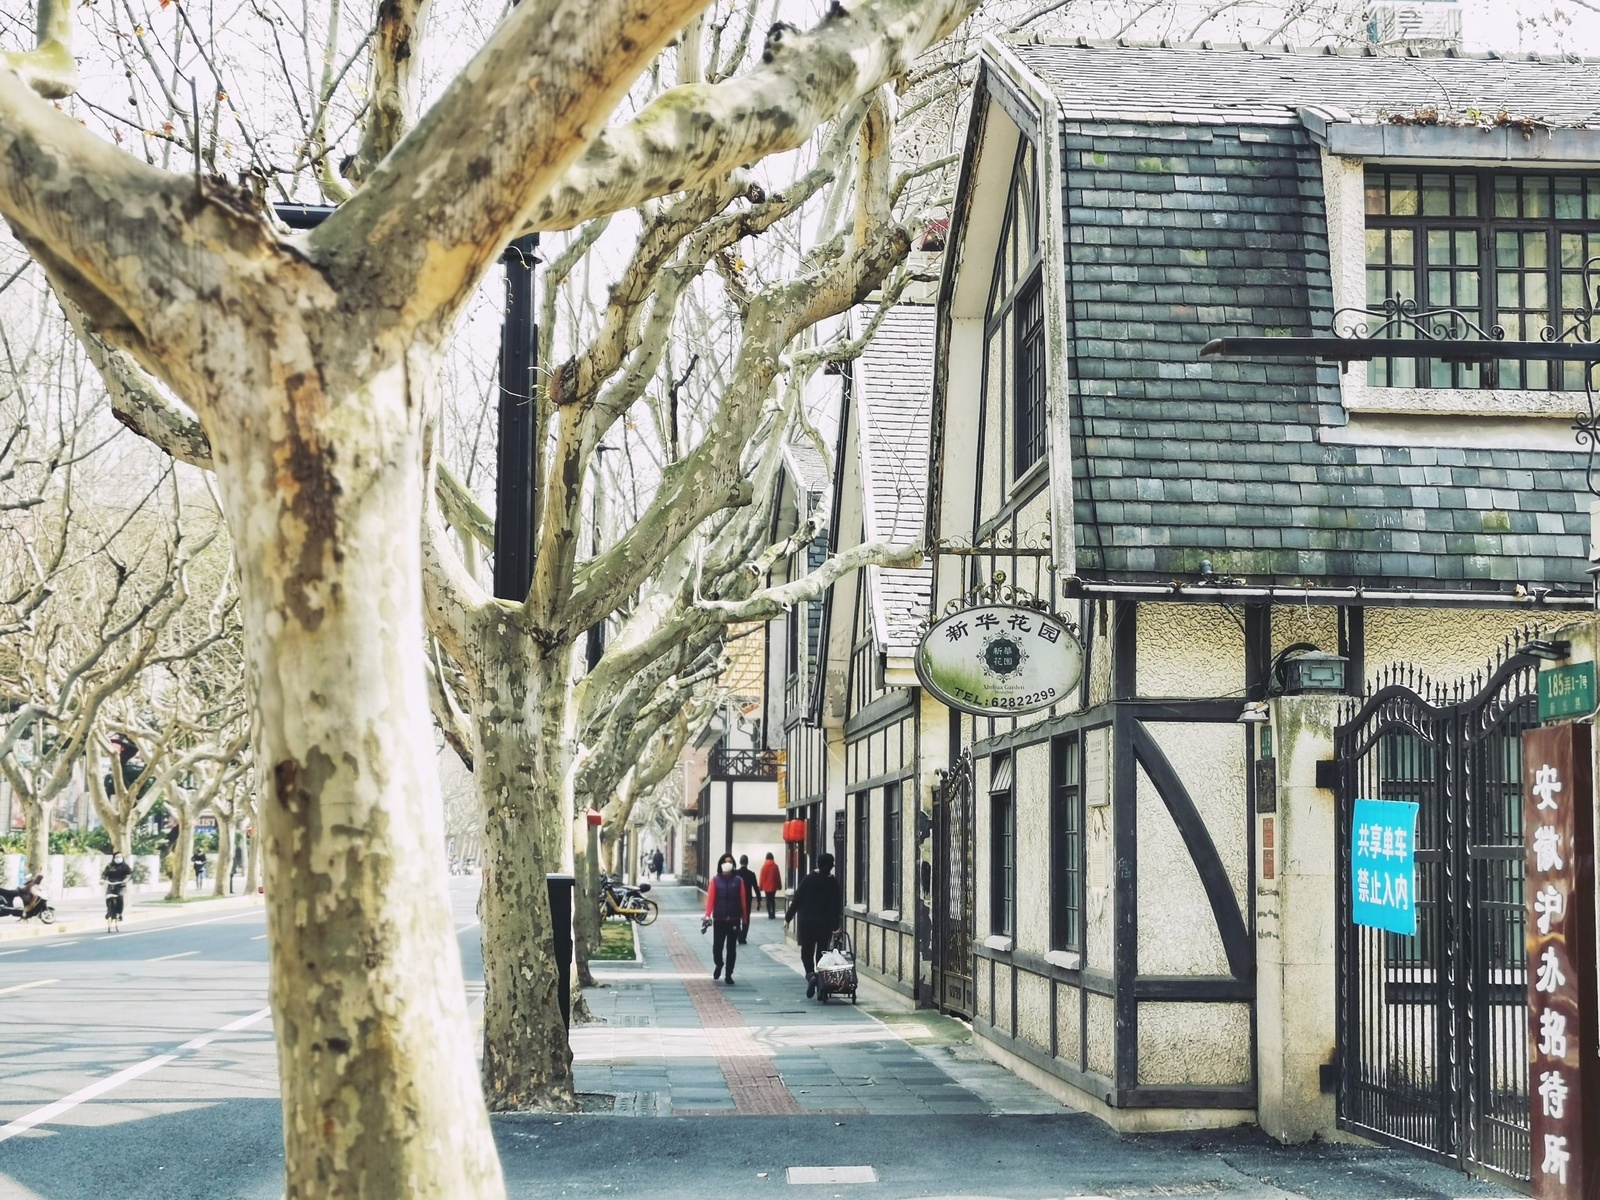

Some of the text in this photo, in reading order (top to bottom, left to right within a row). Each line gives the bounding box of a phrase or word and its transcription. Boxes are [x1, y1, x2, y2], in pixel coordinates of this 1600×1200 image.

[945, 613, 1060, 644] 新华花园
[954, 687, 1056, 708] TEL:62822299
[1358, 823, 1408, 863] 共享单车
[1357, 868, 1409, 910] 禁止入内
[1532, 763, 1570, 1185] 安徽沪办招待所
